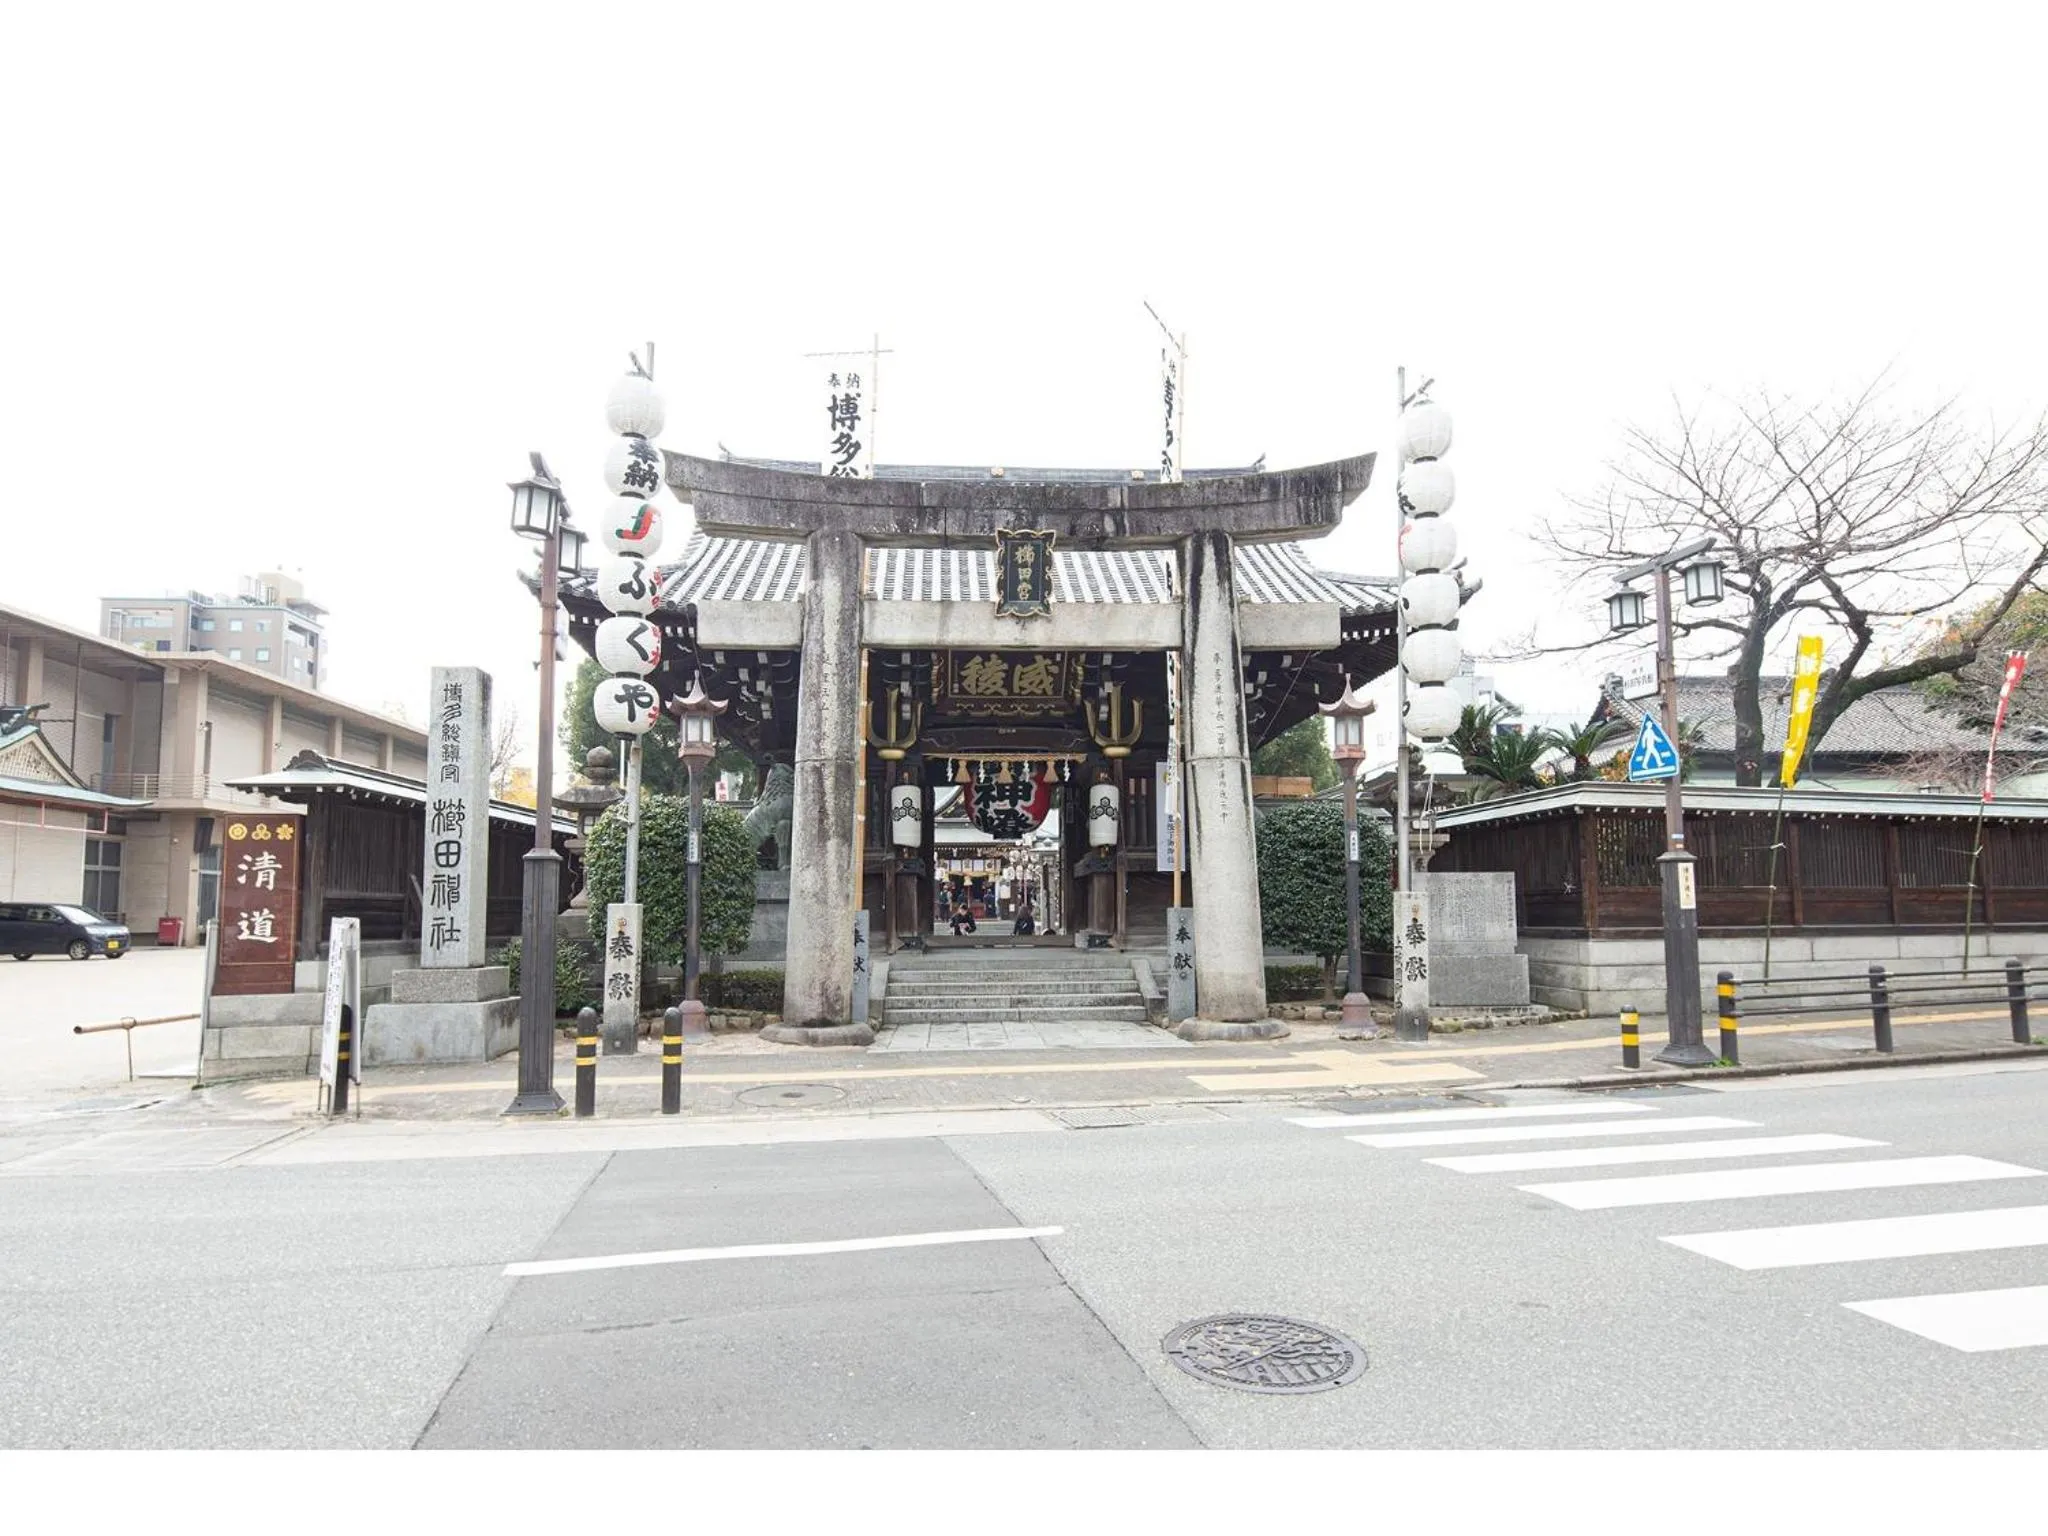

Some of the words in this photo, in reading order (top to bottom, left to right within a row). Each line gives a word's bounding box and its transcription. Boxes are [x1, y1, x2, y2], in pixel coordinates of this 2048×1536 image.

[828, 372, 860, 388] 奉納
[623, 439, 659, 493] 奉納
[614, 561, 657, 723] ふくや
[237, 851, 283, 943] 清道
[429, 798, 465, 951] 櫛田神社
